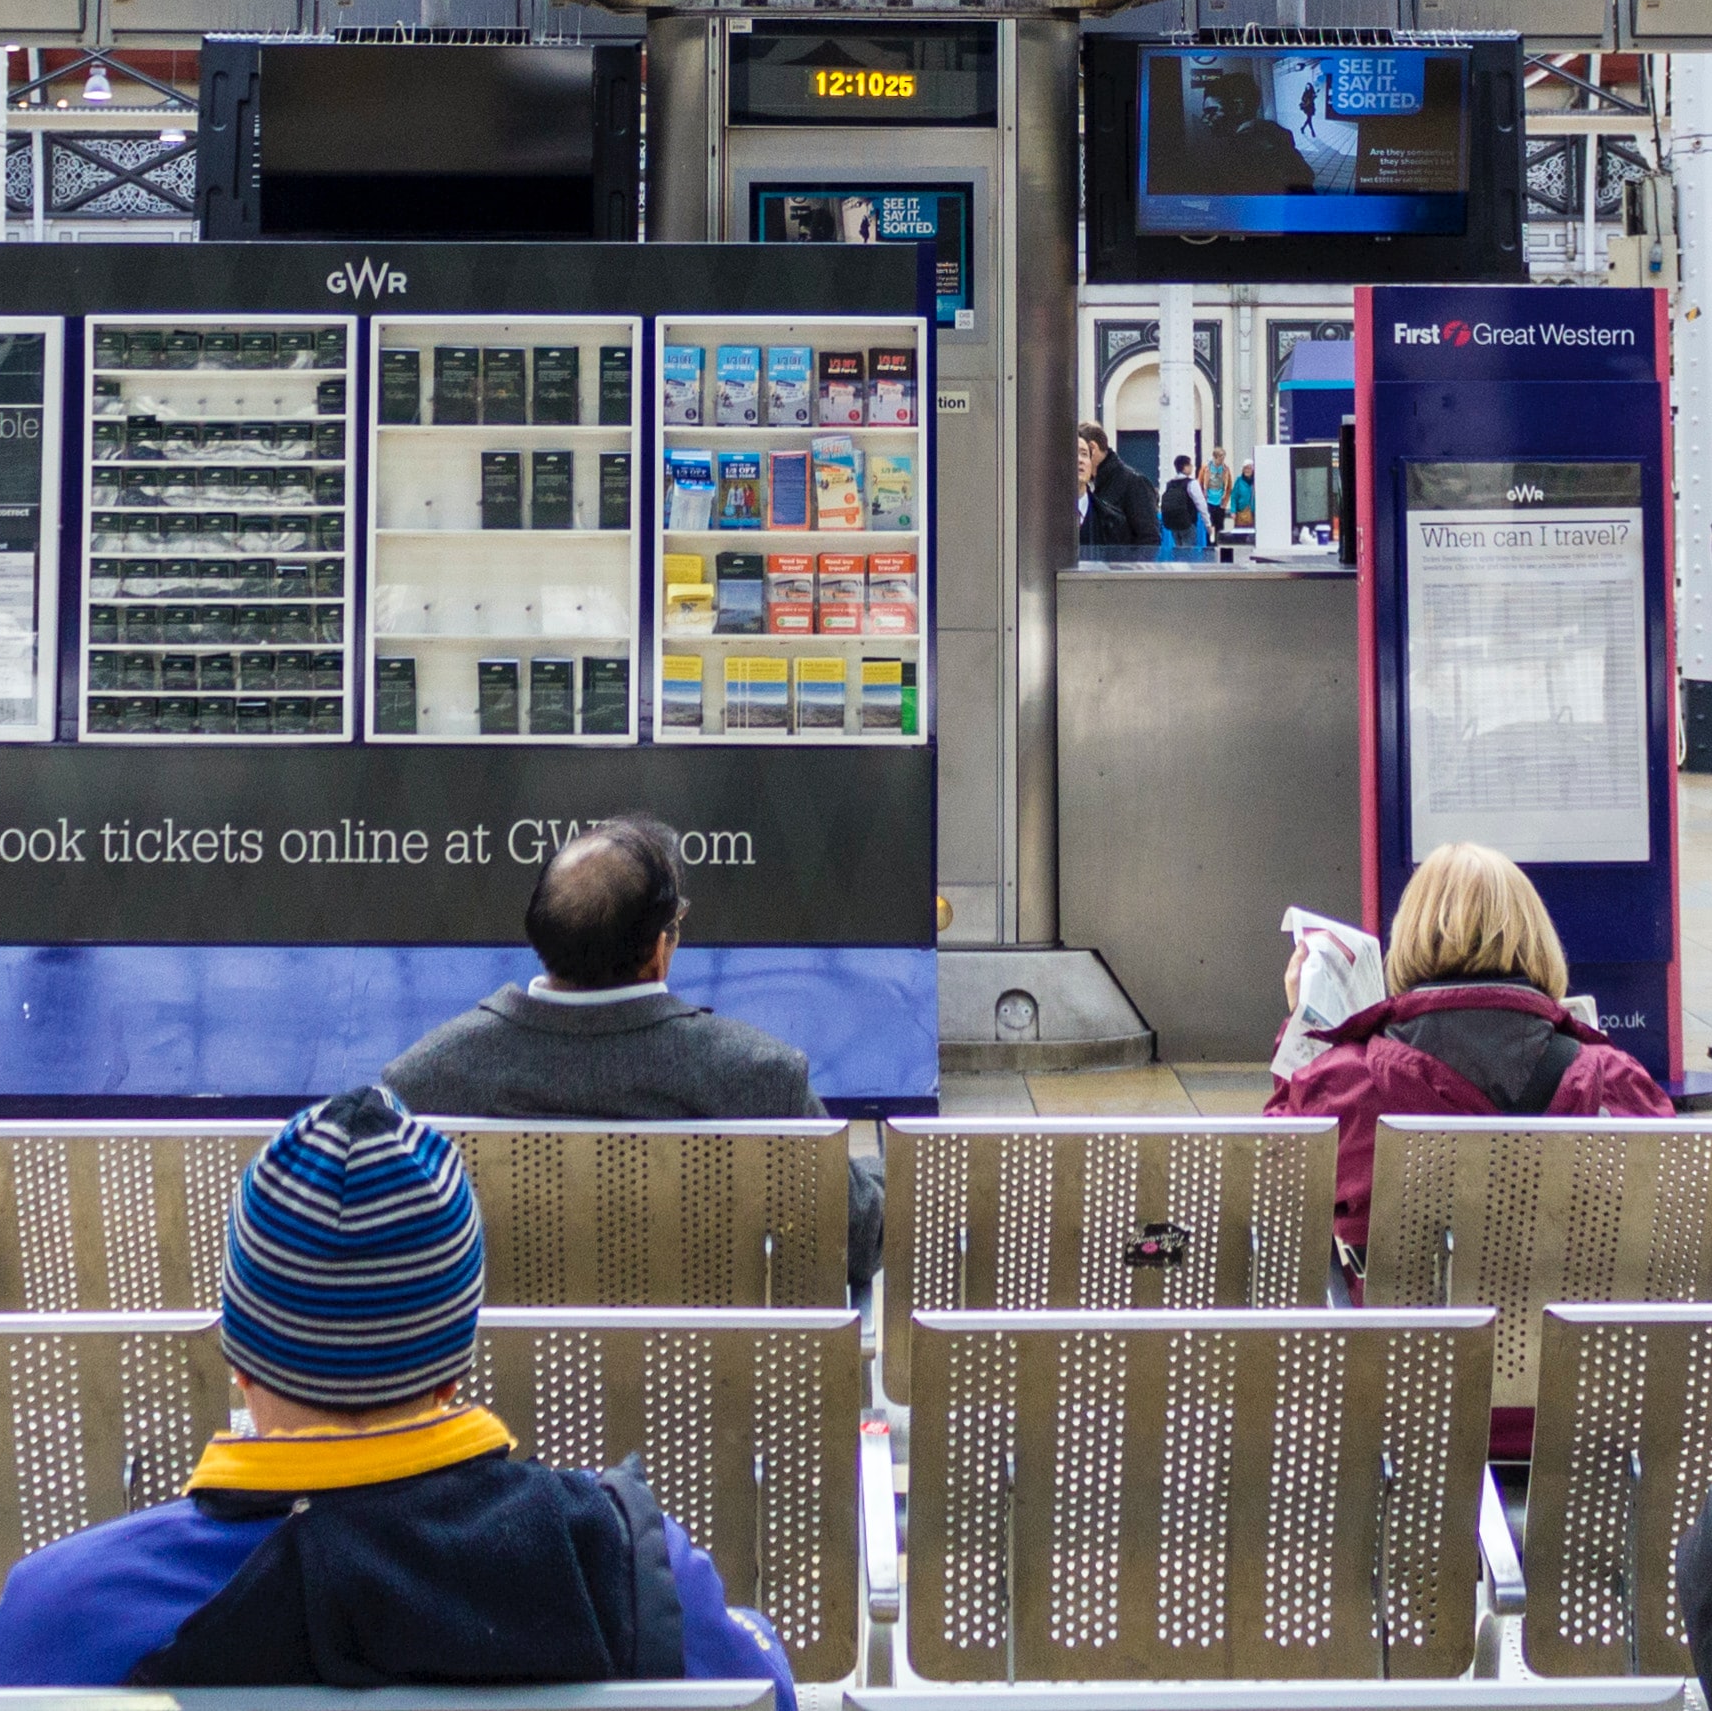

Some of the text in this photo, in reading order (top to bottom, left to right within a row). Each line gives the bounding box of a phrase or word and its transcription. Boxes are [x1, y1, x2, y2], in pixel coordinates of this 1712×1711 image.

[1339, 59, 1396, 74] SEE IT.
[1338, 76, 1396, 91] SAY IT.
[1337, 92, 1419, 109] SORTED.
[883, 198, 920, 210] SEE IT.
[883, 210, 920, 221] SAY IT.
[882, 223, 935, 234] SORTED.
[326, 256, 408, 300] GWR
[1394, 323, 1635, 345] First Great Western
[1506, 483, 1544, 502] GWR
[1421, 525, 1629, 548] When can I travel?
[99, 818, 263, 863] tickets
[279, 819, 429, 864] online
[444, 823, 492, 864] at
[1600, 1010, 1646, 1028] co.uk
